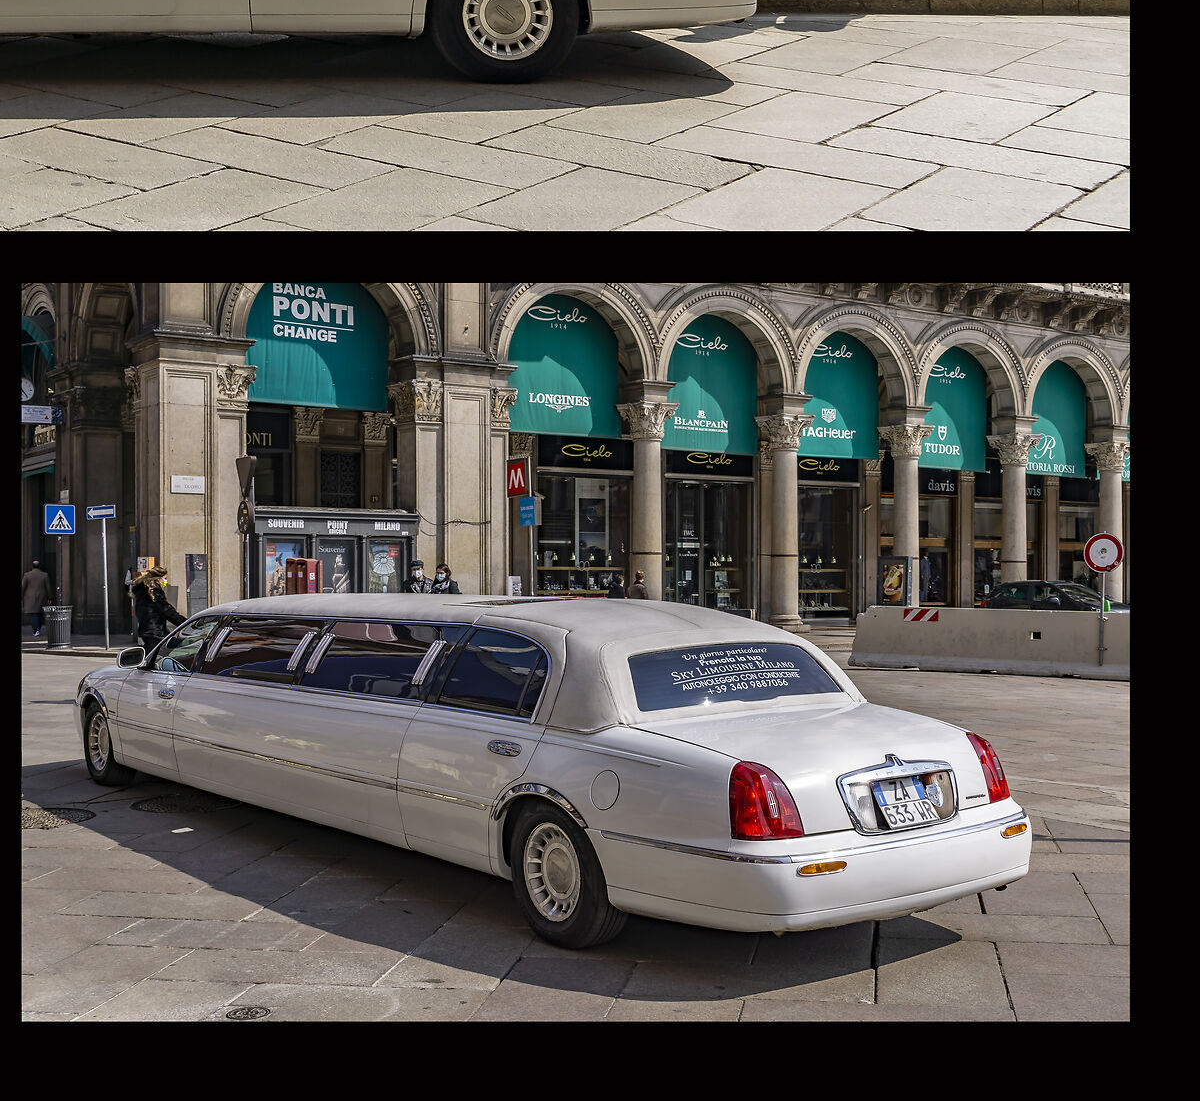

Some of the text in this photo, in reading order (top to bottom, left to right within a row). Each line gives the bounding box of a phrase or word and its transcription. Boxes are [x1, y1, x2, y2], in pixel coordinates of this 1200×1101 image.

[272, 283, 327, 300] BANCA
[273, 295, 354, 326] PONTI
[527, 305, 588, 323] Cielo
[550, 322, 567, 330] 1914
[273, 324, 337, 343] CHANGE
[676, 333, 729, 350] Cielo
[528, 392, 590, 407] LONGINES
[674, 417, 729, 429] BLANCPAIN
[561, 444, 613, 458] Cielo
[924, 442, 960, 456] TUDOR
[687, 452, 732, 464] Cielo
[799, 459, 840, 471] Cielo
[1053, 464, 1075, 474] ROSSI
[508, 467, 525, 490] M
[928, 479, 955, 491] davis
[267, 519, 401, 531] SOUVENIR POINT MILANO
[318, 545, 346, 553] Souvenir
[682, 647, 768, 661] Un giorno particolare?
[698, 656, 736, 667] Prenota
[682, 671, 800, 691] AUTONOLEGGIO CON CONDUCENTE
[707, 679, 789, 695] +39 340 9887056
[888, 781, 911, 801] ZA
